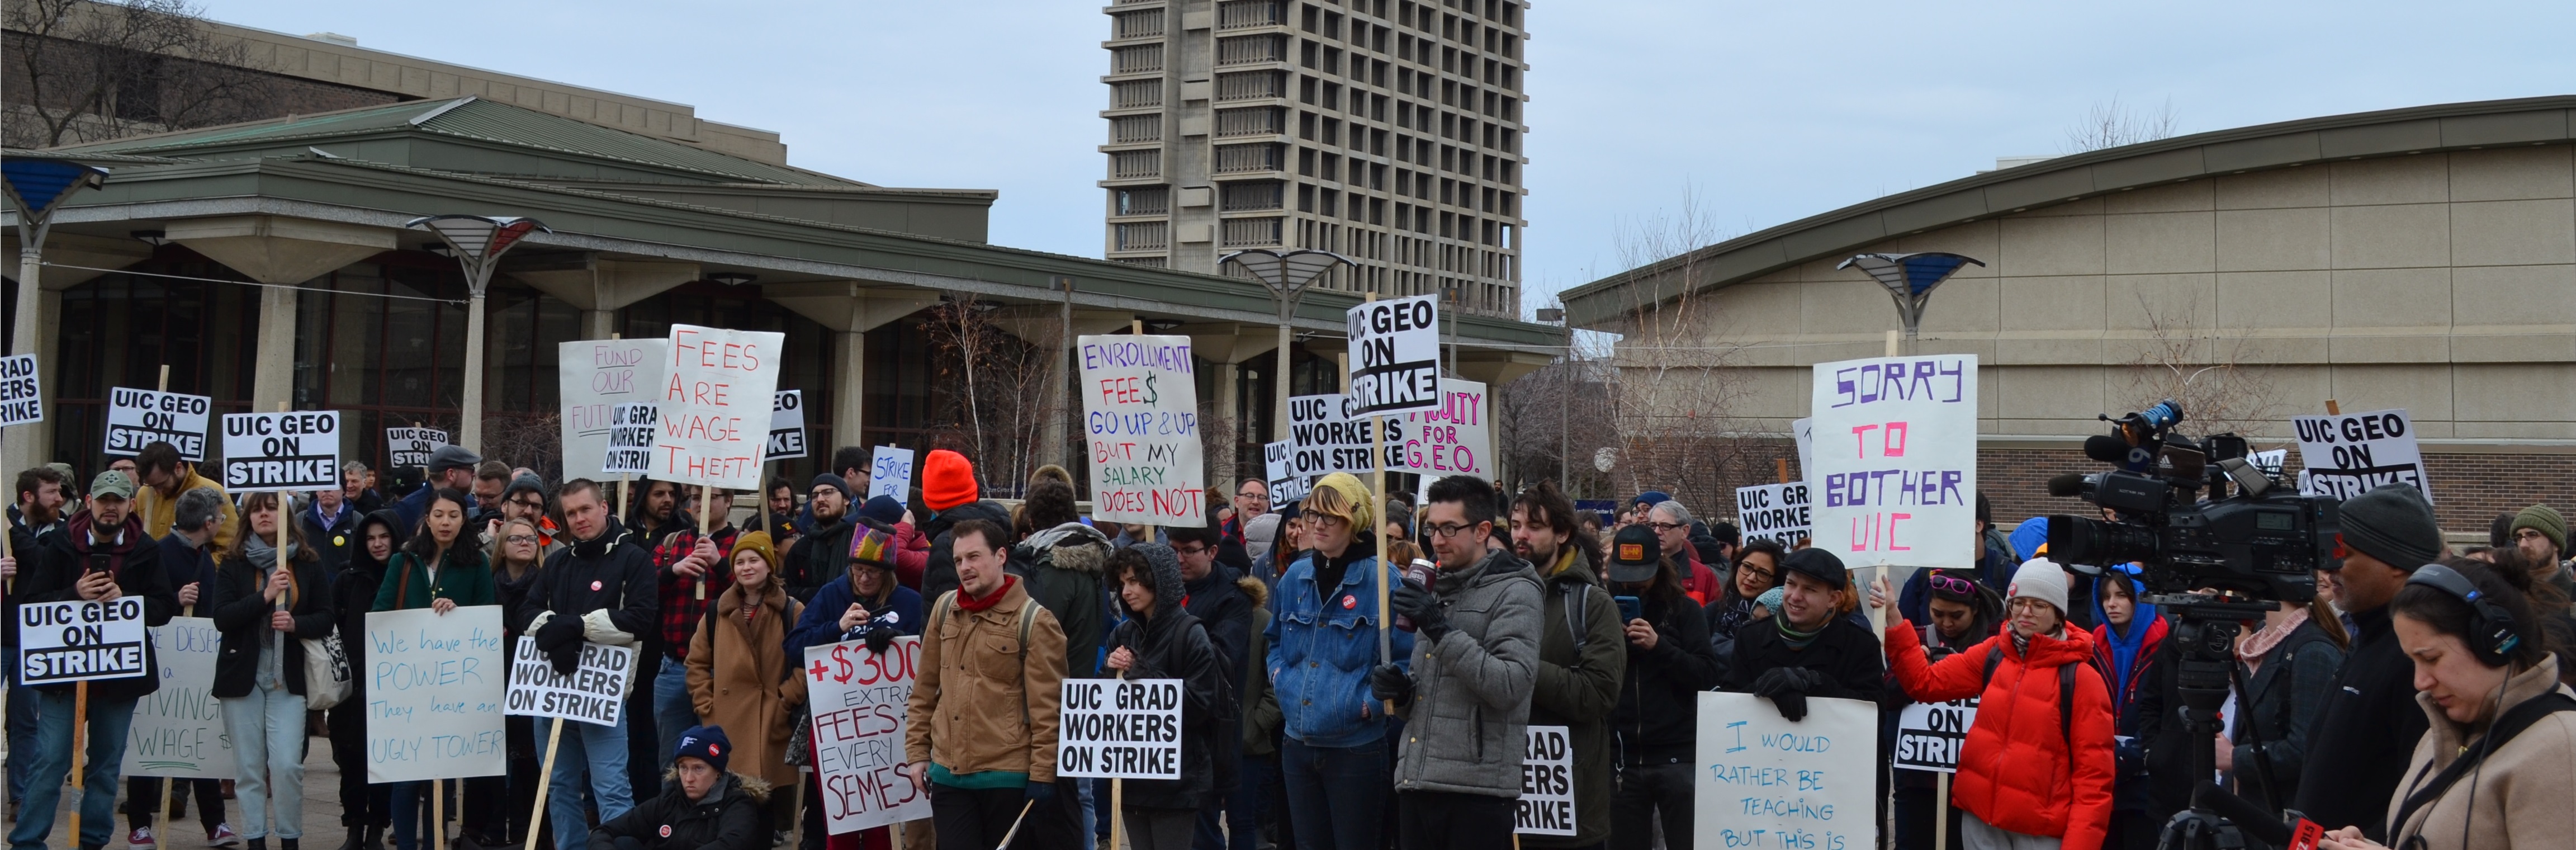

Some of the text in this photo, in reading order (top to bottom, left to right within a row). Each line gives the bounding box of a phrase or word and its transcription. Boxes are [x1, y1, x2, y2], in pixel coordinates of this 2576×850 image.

[1348, 300, 1433, 342] UIC GEO
[595, 346, 643, 365] FUND
[676, 330, 759, 371] FEES
[1084, 342, 1190, 373] ENROLLMENT
[1362, 336, 1395, 368] ON
[593, 370, 634, 393] OUR
[669, 372, 728, 405] ARE
[1100, 370, 1158, 409] FEE$
[1352, 367, 1435, 410] STRIKE
[1831, 360, 1962, 408] SORRY
[115, 390, 206, 414] UIC GEO
[1291, 399, 1327, 422] UIC
[143, 412, 174, 430] ON
[226, 414, 335, 437] UIC GEO
[613, 407, 625, 425] UIC
[664, 414, 741, 441] WAGE
[1090, 411, 1196, 437] GO UP & UP
[2295, 413, 2404, 443] UIC GEO
[110, 428, 201, 456] STRIKE
[262, 437, 300, 457] ON
[390, 429, 446, 443] UIC GEO
[411, 440, 432, 451] ON
[1423, 426, 1458, 445] FOR
[1852, 422, 1907, 460] TO
[394, 452, 432, 464] STRI
[606, 451, 617, 469] ON
[659, 444, 760, 478] THEFT!
[1095, 441, 1178, 466] BUT MY
[1267, 443, 1286, 463] UIC
[1296, 450, 1325, 473] ON
[1407, 440, 1480, 473] G.E.O.
[2332, 444, 2375, 469] ON
[228, 459, 334, 484] STRIKE
[875, 457, 910, 479] STRIKE
[1102, 464, 1164, 487] $ALARY
[884, 484, 898, 496] FOR
[1272, 476, 1309, 503] STRIKE
[1741, 485, 1811, 510] UIC GR
[1826, 469, 1963, 507] BOTHER
[1742, 506, 1811, 532] WORKE
[1852, 512, 1911, 551] UIC
[25, 600, 141, 627] UIC GEO
[1343, 598, 1355, 606] GEO
[62, 624, 103, 647] ON
[371, 627, 499, 654] We have the
[26, 646, 140, 677] STRIKE
[578, 645, 627, 671] RAD
[164, 667, 174, 678] a
[377, 657, 483, 691] POWER
[133, 687, 219, 720] IVING
[370, 695, 497, 723] They have an
[509, 689, 618, 722] ON STRIKE
[1066, 683, 1177, 710] UIC GRAD
[815, 704, 898, 744] FEES
[1064, 714, 1177, 742] WORKERS
[1928, 708, 1963, 733] ON
[134, 726, 206, 759] WAGE
[372, 730, 504, 763] UGLY TOWER
[1726, 721, 1830, 753] I WOULD
[821, 737, 893, 774] EVERY
[1062, 747, 1176, 774] ON STRIKE
[1710, 764, 1824, 791] RATHER BE
[827, 762, 917, 821] SEMES
[1720, 829, 1765, 848] BUT
